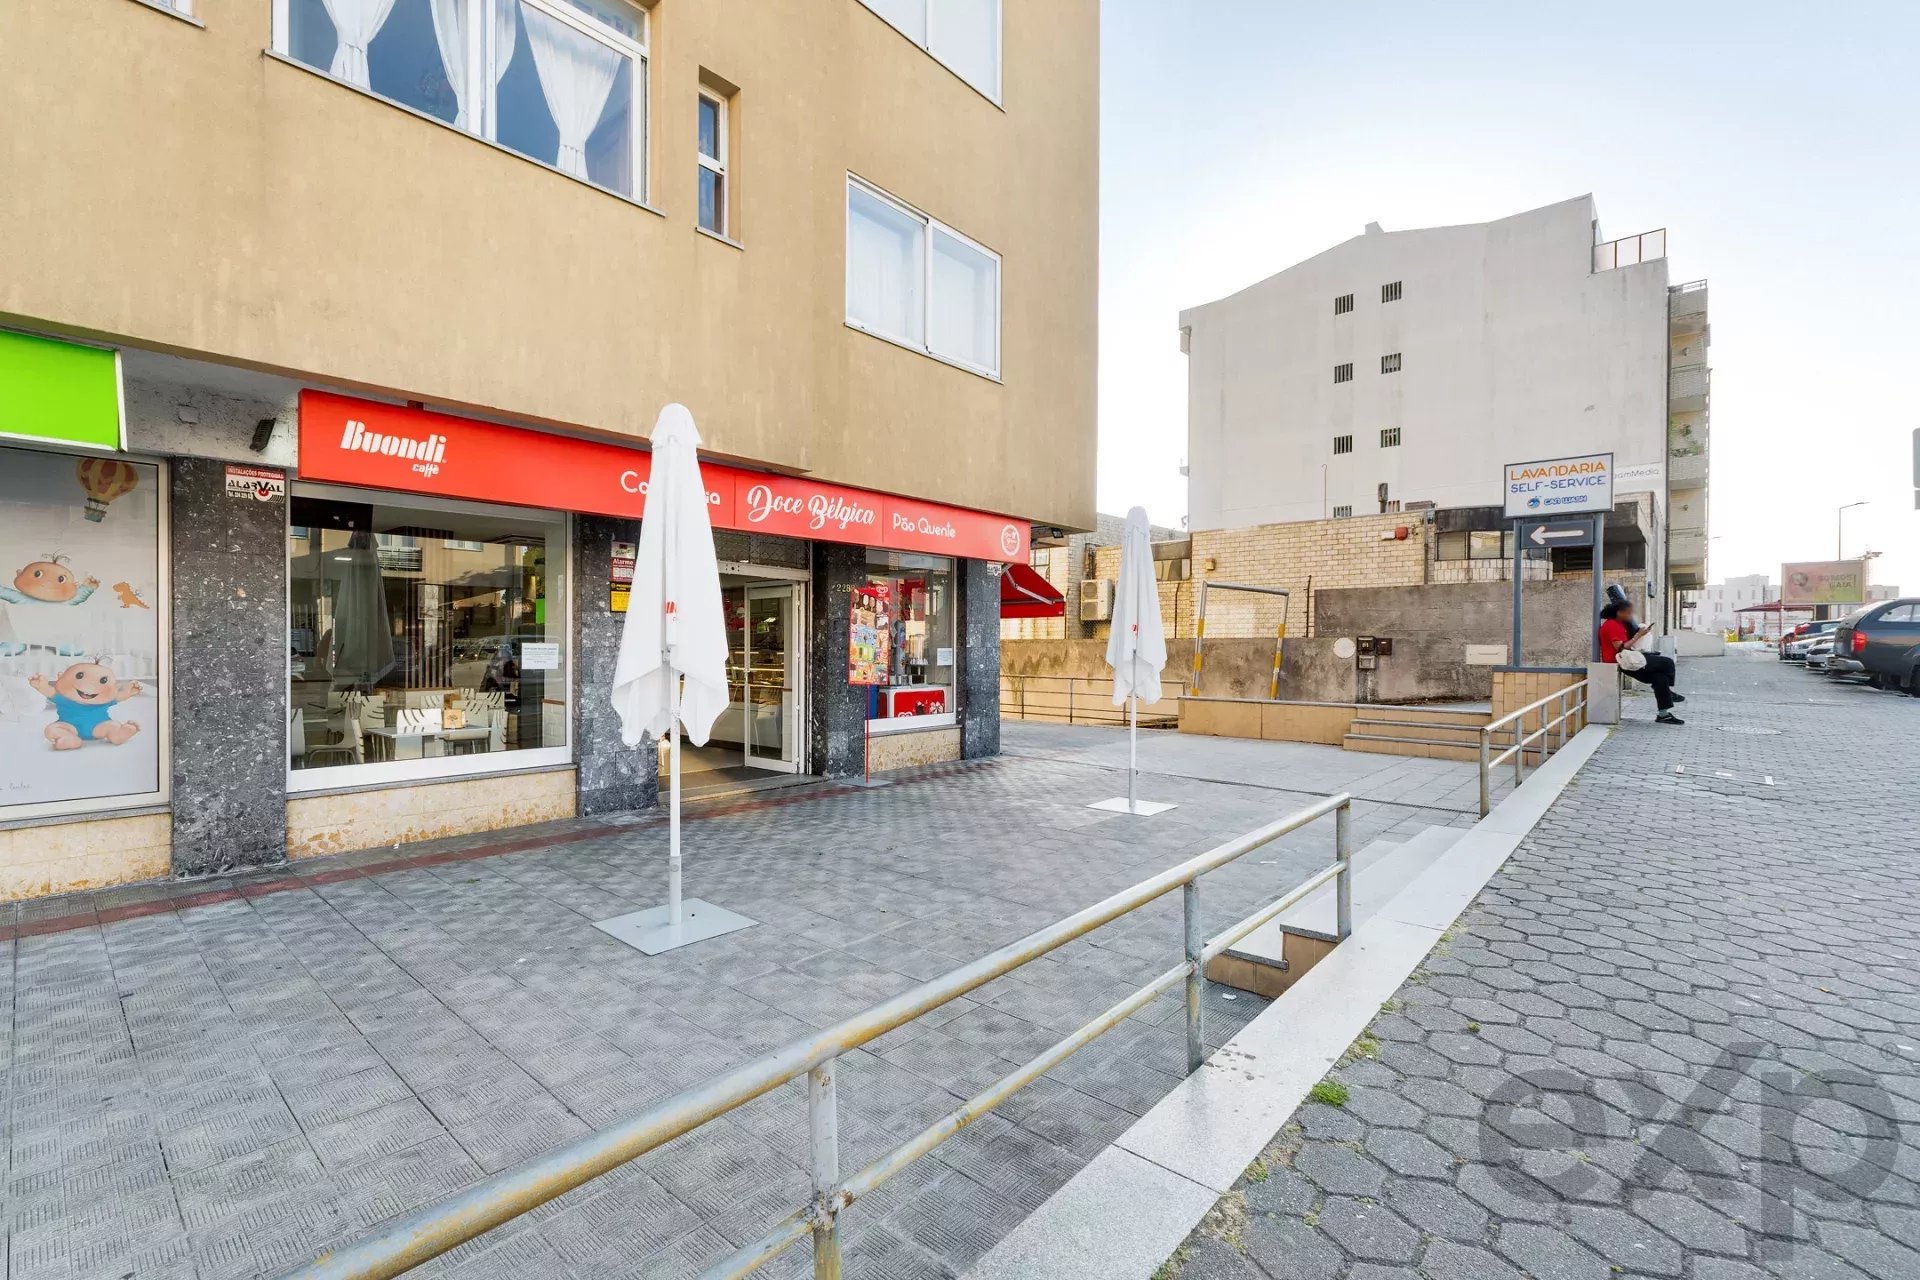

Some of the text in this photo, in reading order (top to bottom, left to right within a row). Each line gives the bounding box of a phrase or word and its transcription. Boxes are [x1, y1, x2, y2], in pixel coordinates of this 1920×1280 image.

[340, 420, 447, 463] Buondi
[1510, 461, 1606, 481] LAVANDARIA
[228, 480, 283, 493] ALARVAL
[1510, 475, 1607, 493] SELF-SERVICE
[747, 485, 804, 523] Doce
[808, 494, 876, 530] Bélgica
[893, 513, 956, 538] Pão Quente
